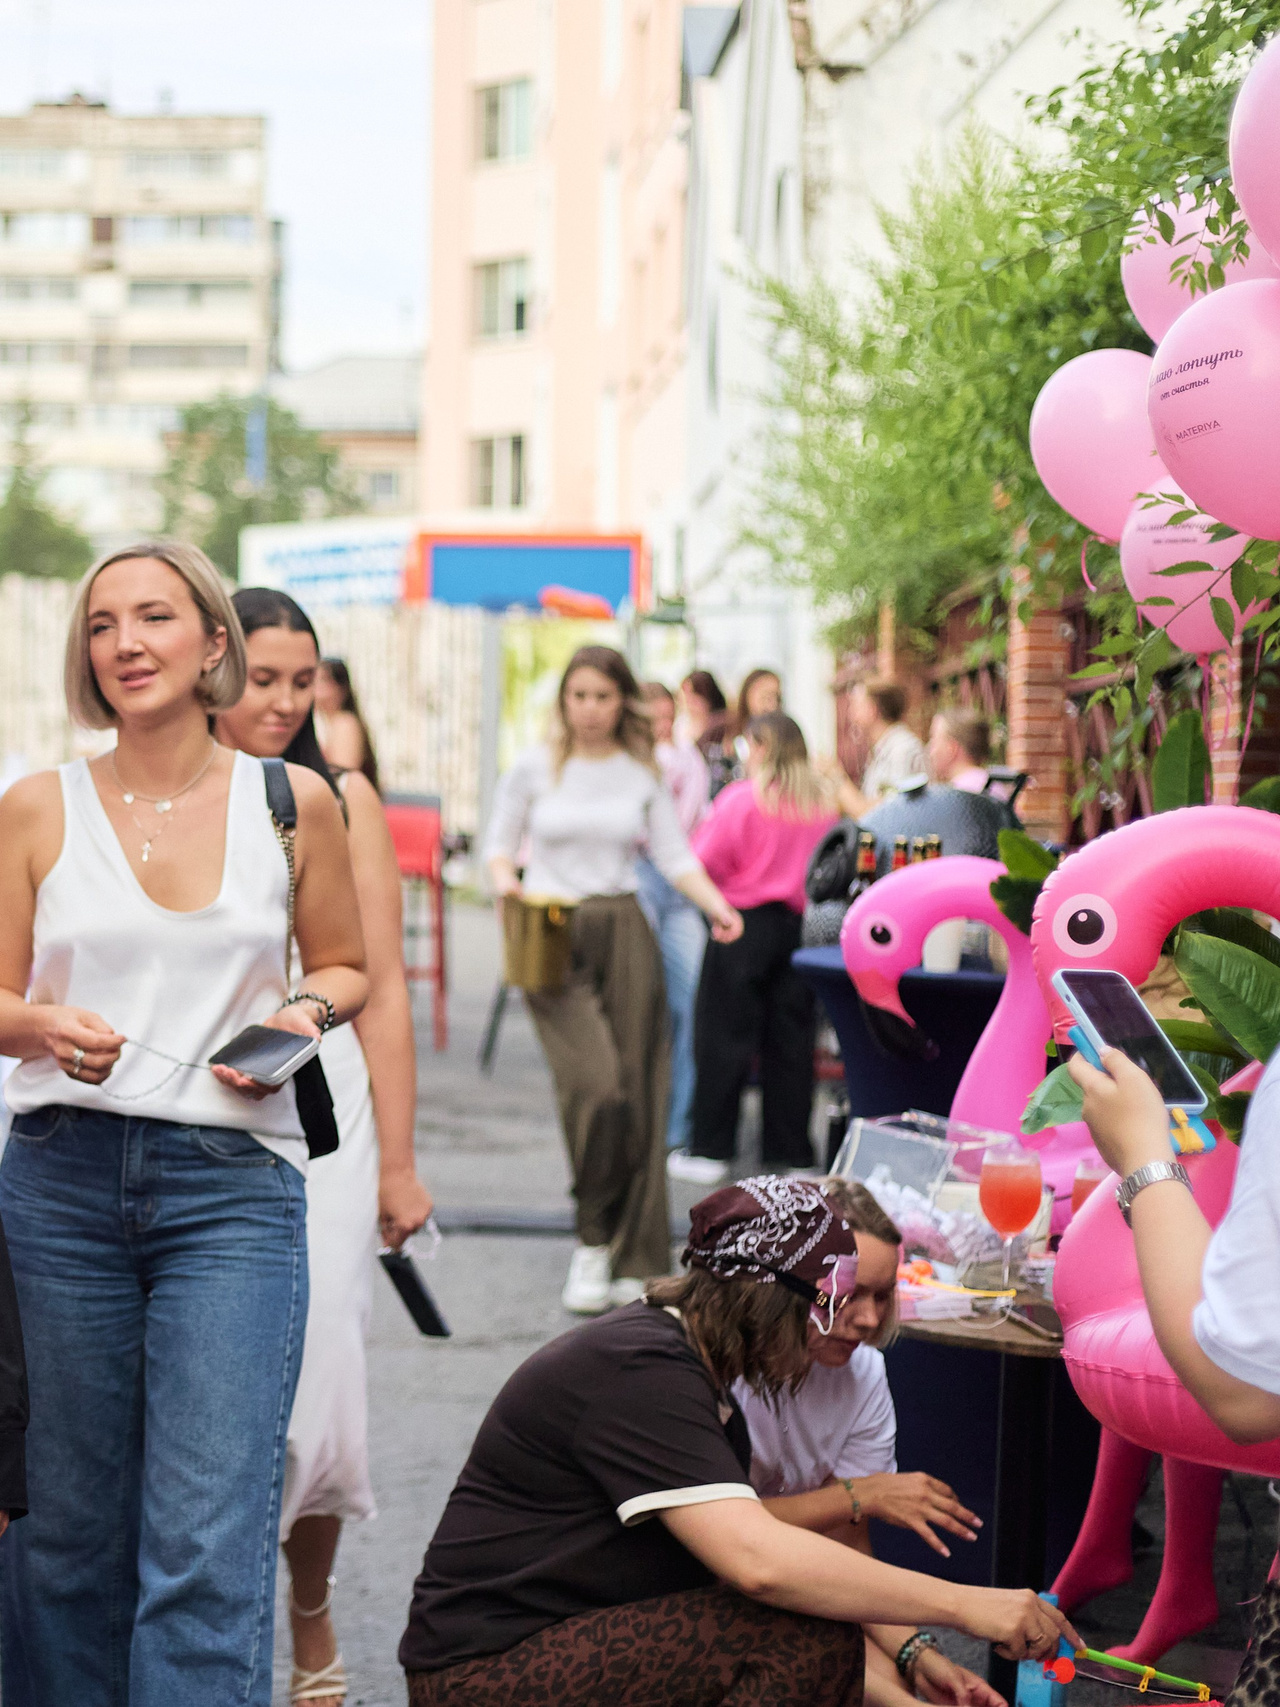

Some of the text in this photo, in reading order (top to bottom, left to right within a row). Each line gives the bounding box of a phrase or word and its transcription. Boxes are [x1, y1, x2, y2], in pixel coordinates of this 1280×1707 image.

[1175, 349, 1243, 370] лопнуть
[1171, 377, 1210, 395] счастья
[1176, 420, 1221, 440] MATERIYA
